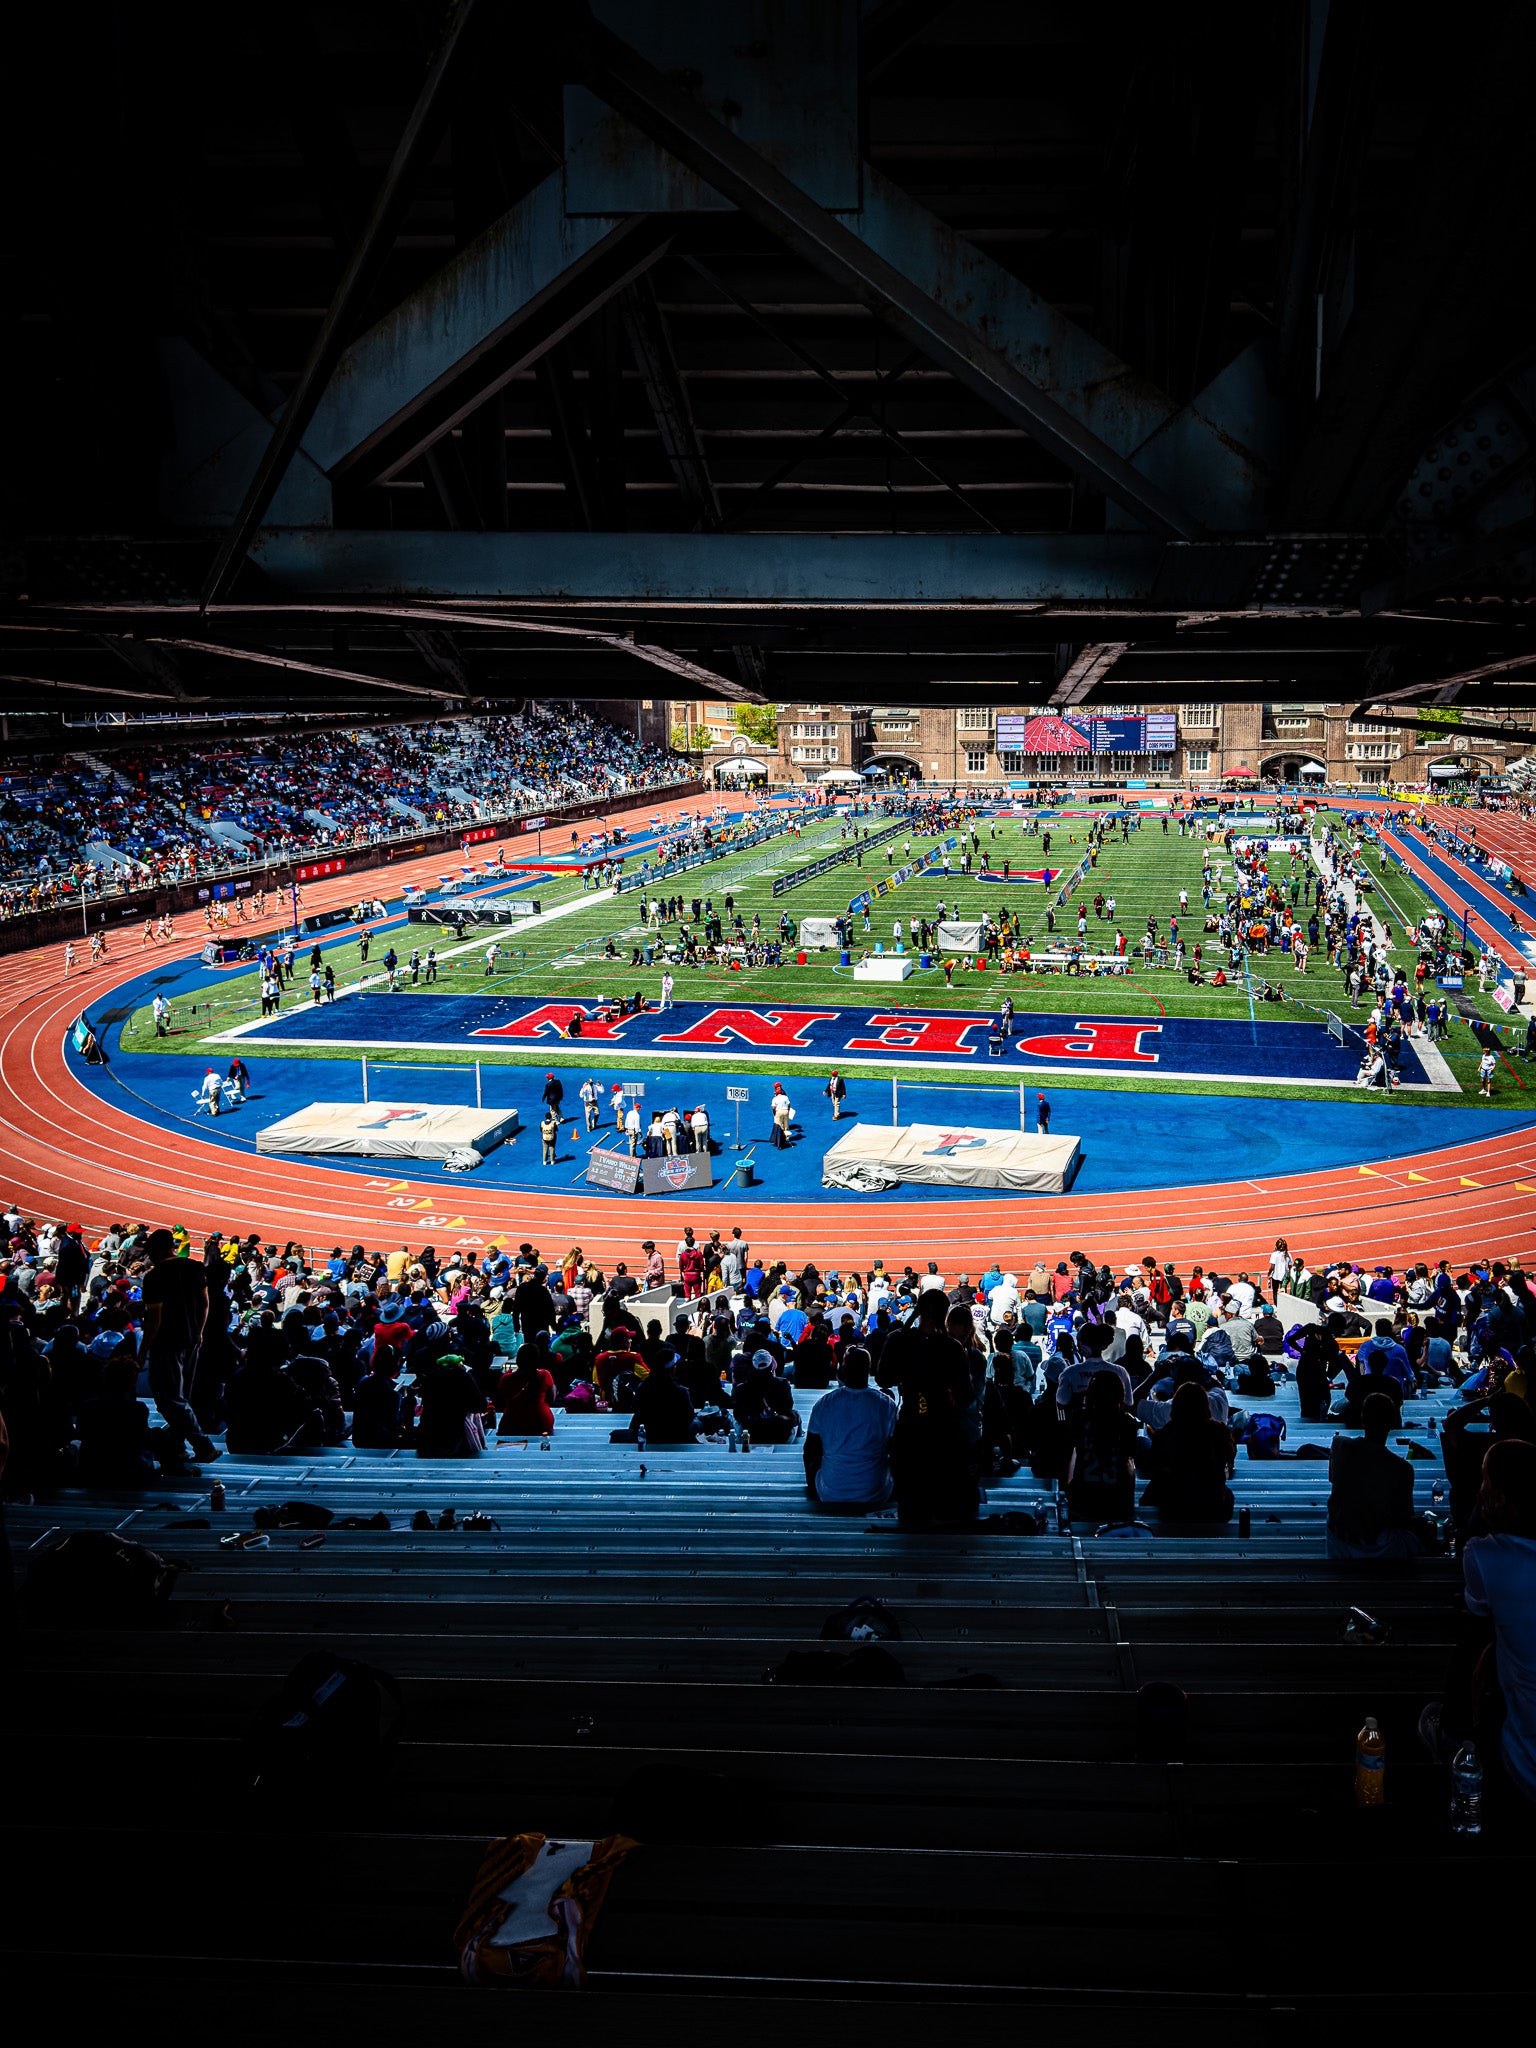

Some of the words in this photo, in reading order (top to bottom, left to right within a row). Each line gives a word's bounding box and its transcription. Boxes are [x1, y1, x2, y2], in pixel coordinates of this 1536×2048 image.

[467, 1003, 1163, 1062] PENN
[365, 1180, 391, 1188] 1
[386, 1197, 416, 1207] 2
[417, 1215, 447, 1226] 3
[455, 1235, 485, 1246] 4
